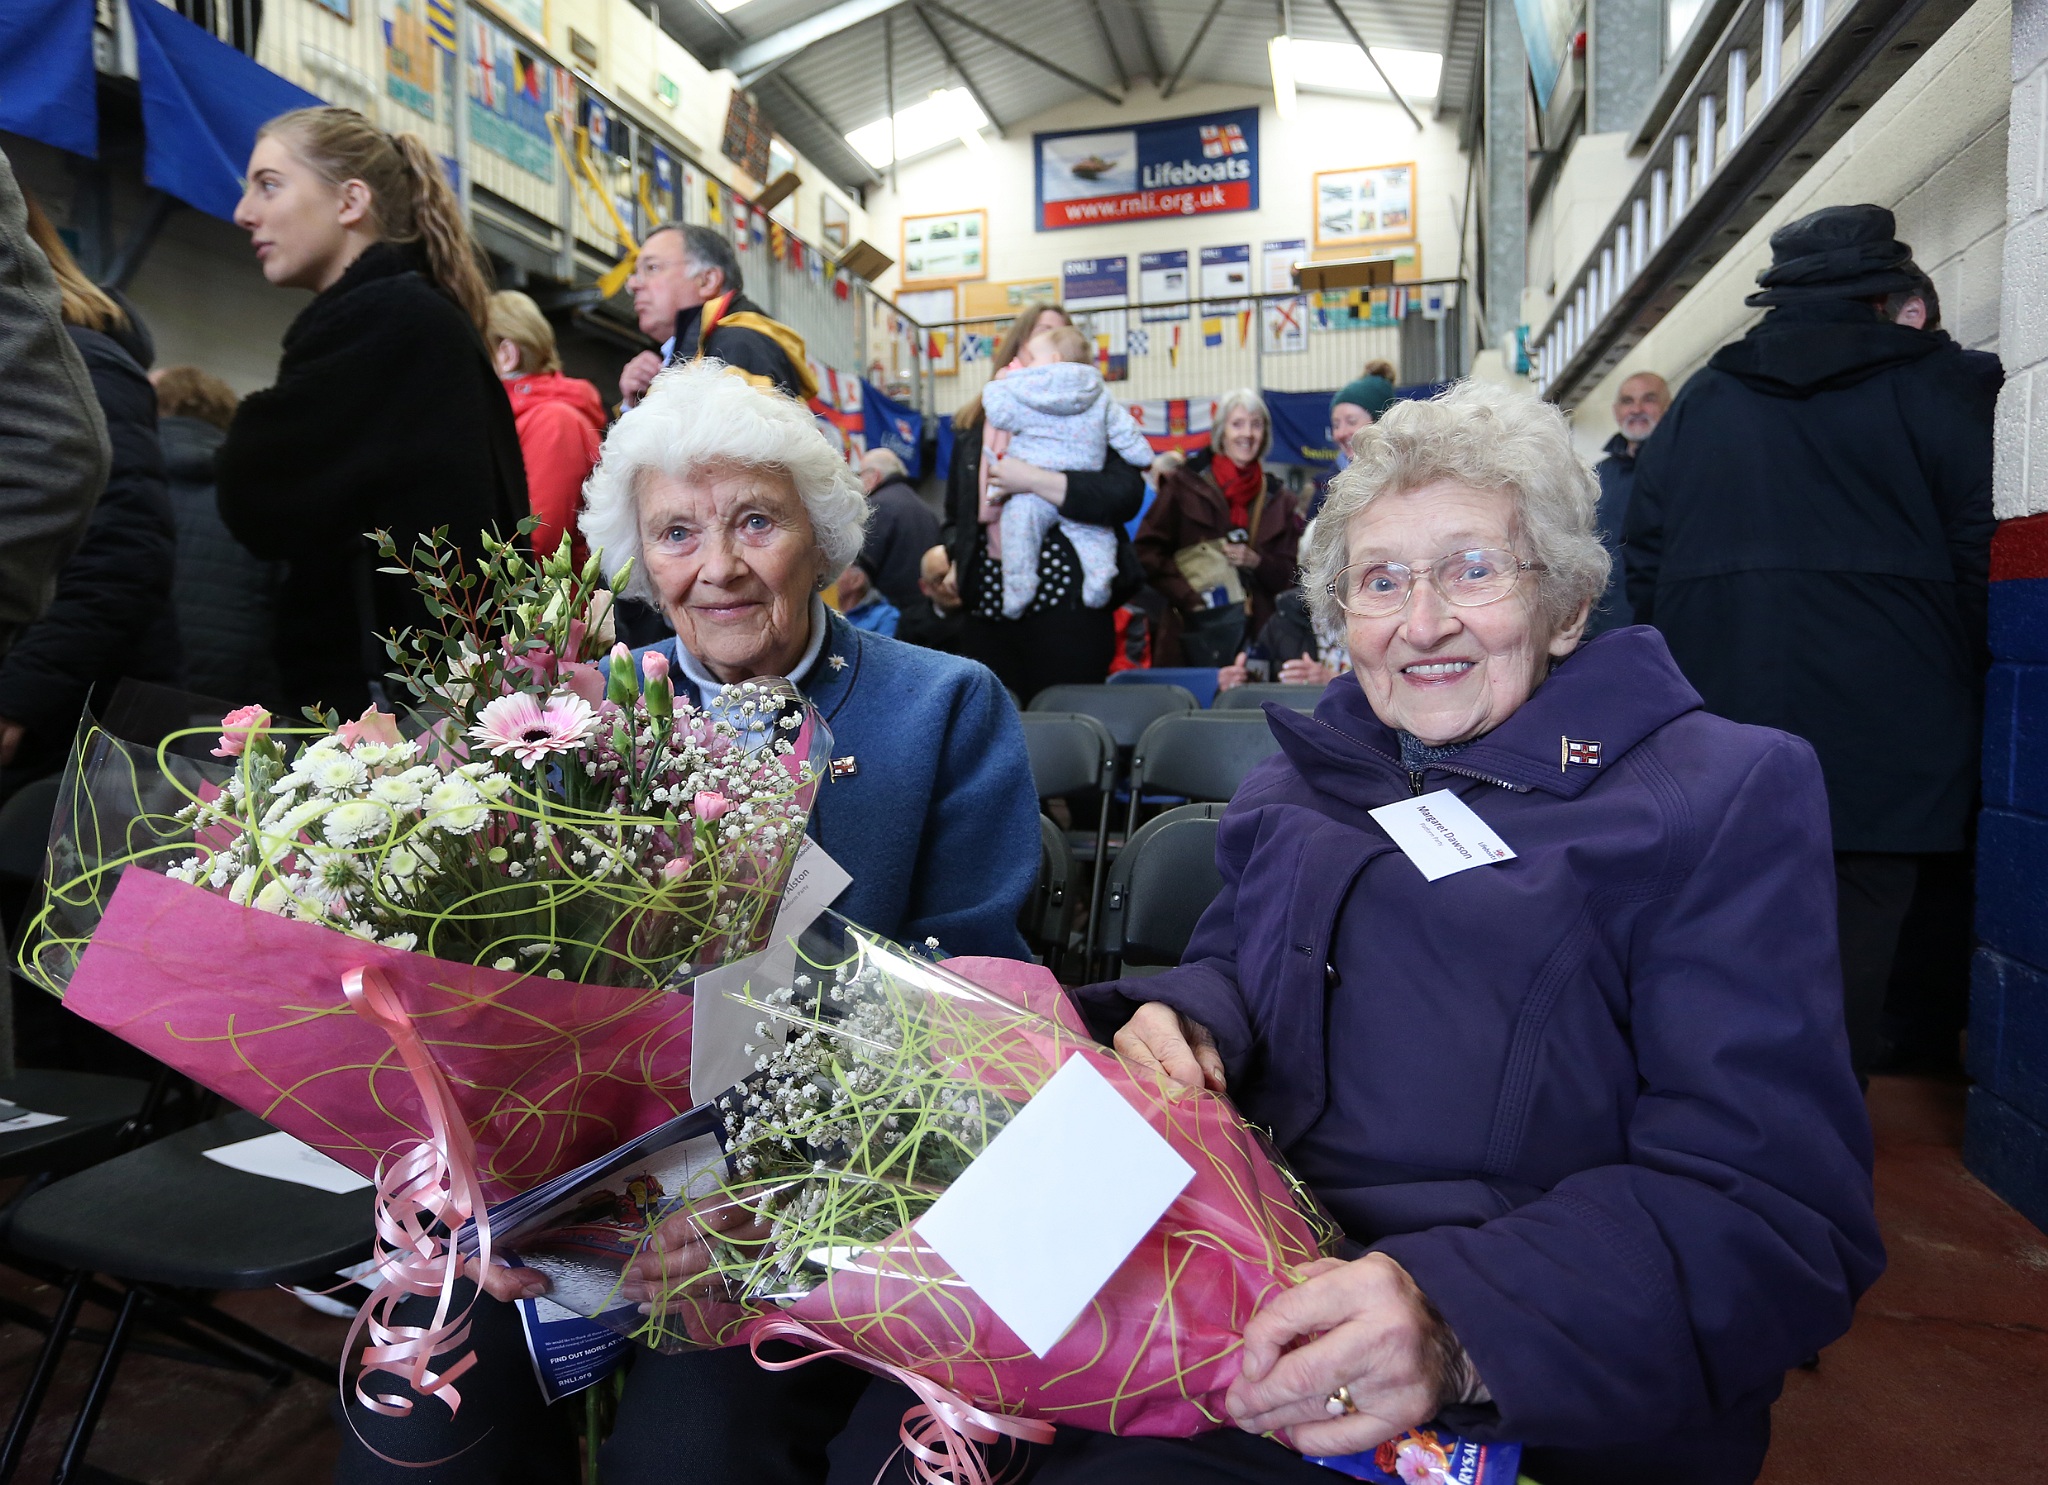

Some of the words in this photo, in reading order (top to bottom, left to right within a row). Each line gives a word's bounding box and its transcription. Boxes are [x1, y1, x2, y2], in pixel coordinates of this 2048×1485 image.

[1143, 157, 1250, 188] Lifeboats
[1065, 185, 1226, 220] www.rnli.org.uk
[1065, 260, 1097, 276] RNLI
[1417, 805, 1448, 832] Margaret
[1444, 832, 1472, 859] Dawson
[1478, 841, 1497, 861] Lifeboats
[785, 869, 810, 894] Alston
[781, 895, 799, 914] Platform
[550, 1355, 567, 1364] FIND
[568, 1351, 583, 1360] OUT
[584, 1344, 607, 1355] MORE
[558, 1372, 592, 1387] RNLI.org
